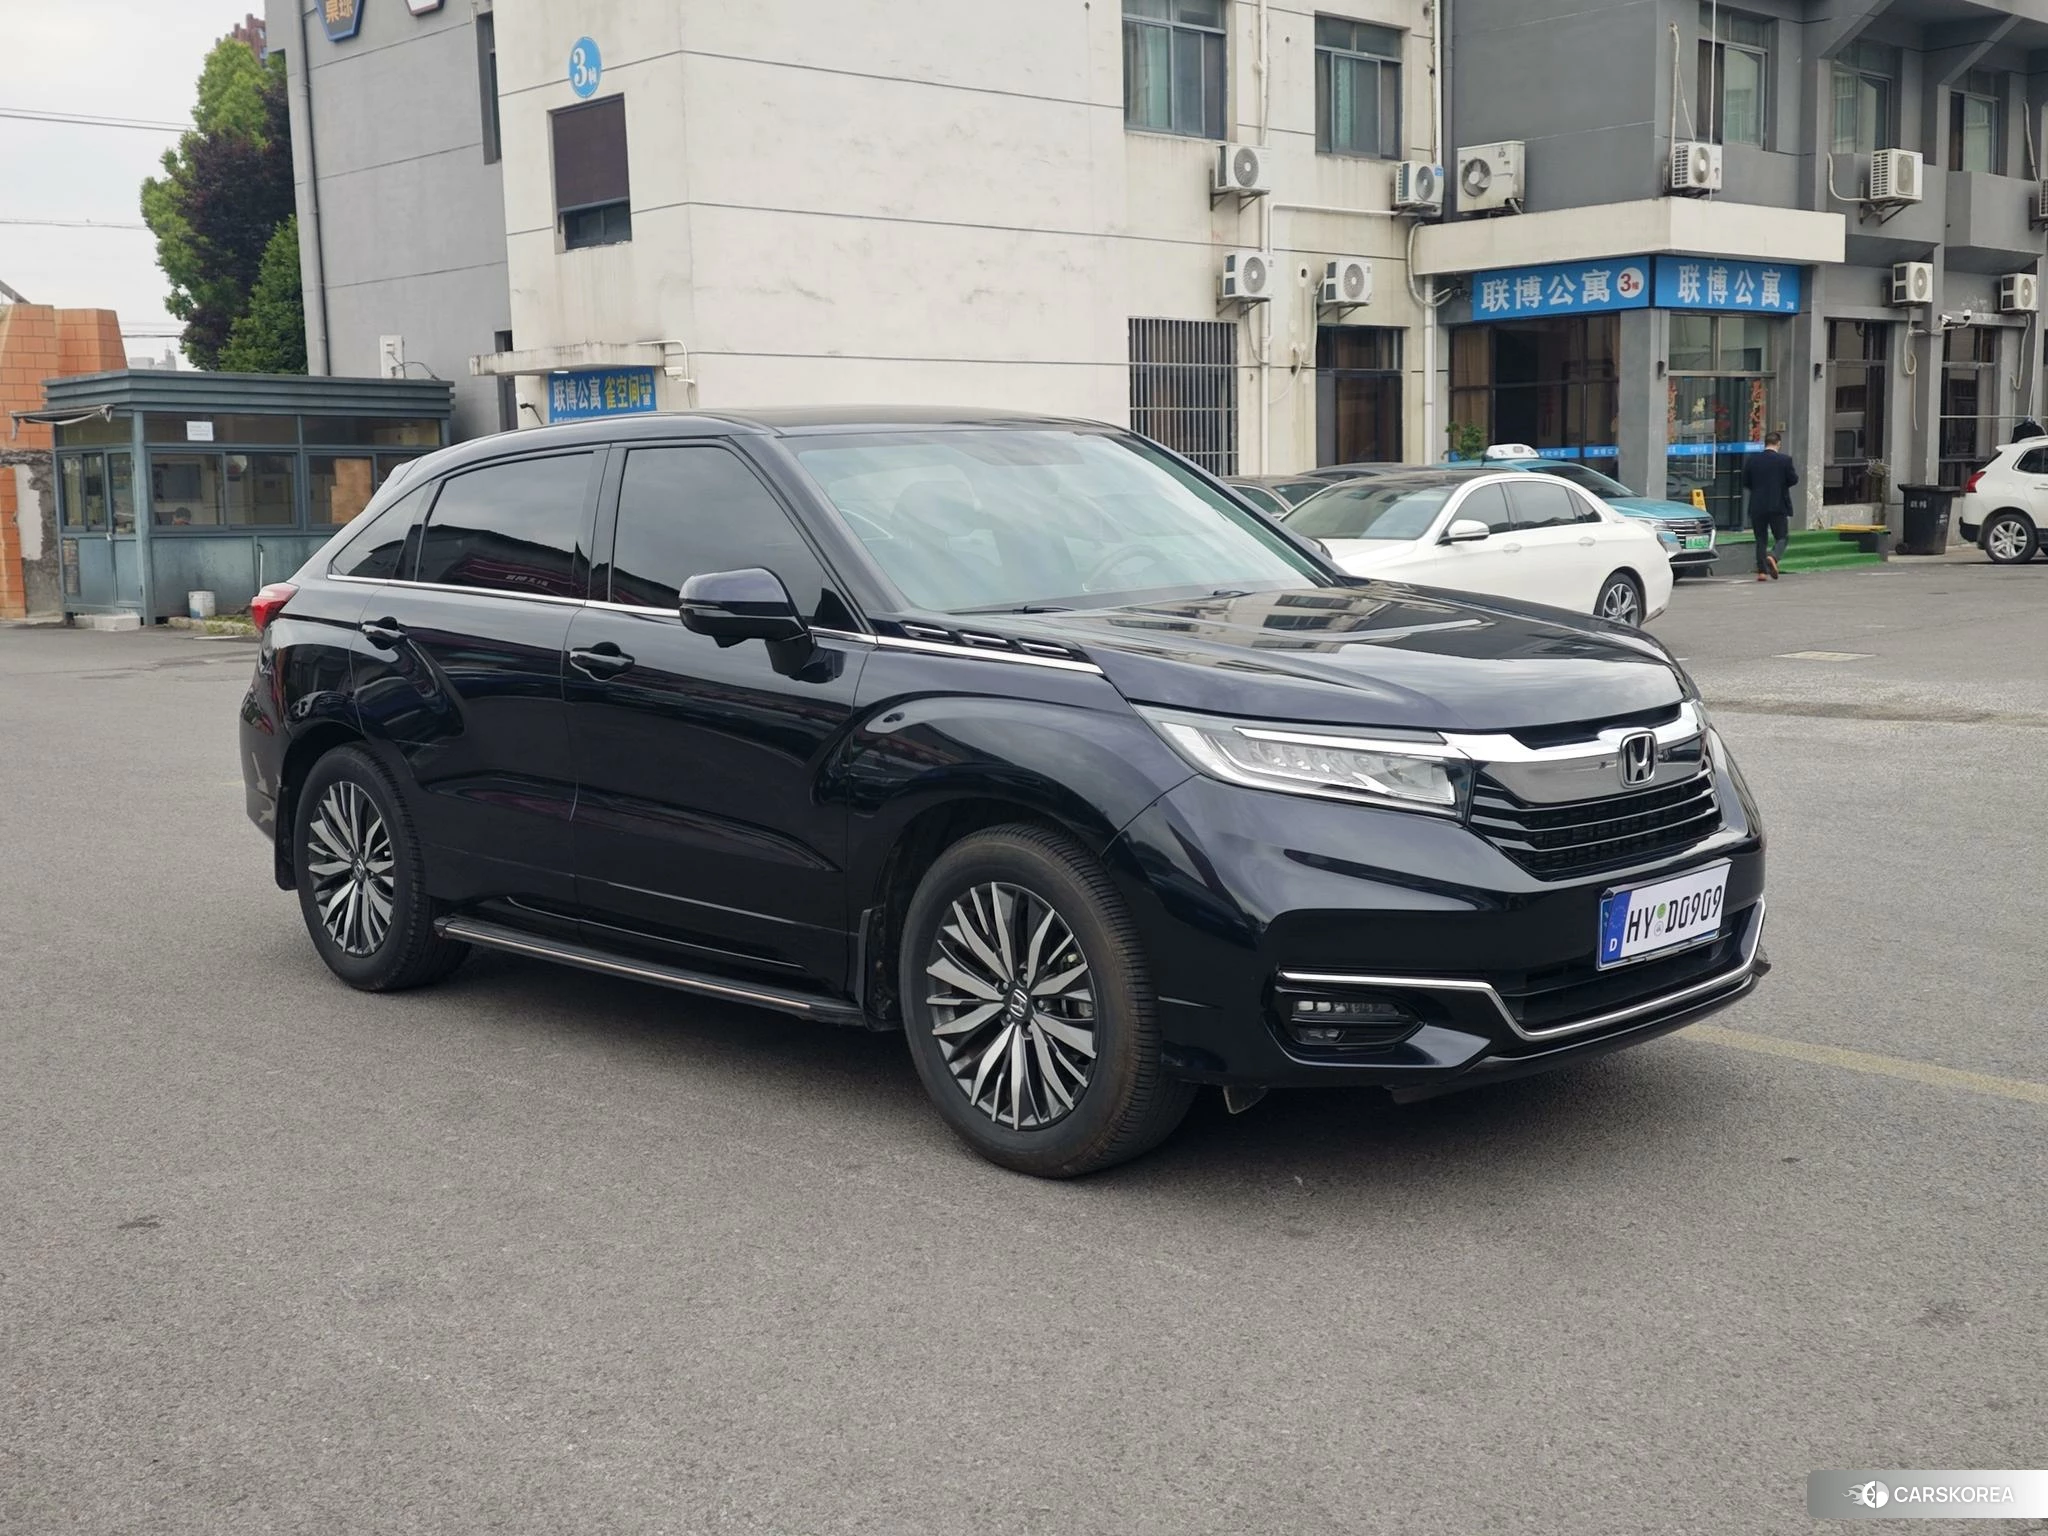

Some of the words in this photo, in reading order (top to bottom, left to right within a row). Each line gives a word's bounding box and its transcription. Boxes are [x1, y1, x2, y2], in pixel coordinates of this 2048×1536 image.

[1481, 269, 1611, 312] 联博公寓
[1678, 264, 1781, 308] 联博公寓
[553, 377, 602, 412] 联博公寓
[1626, 904, 1656, 944] HY
[1665, 885, 1723, 934] D0909
[1609, 938, 1618, 952] D
